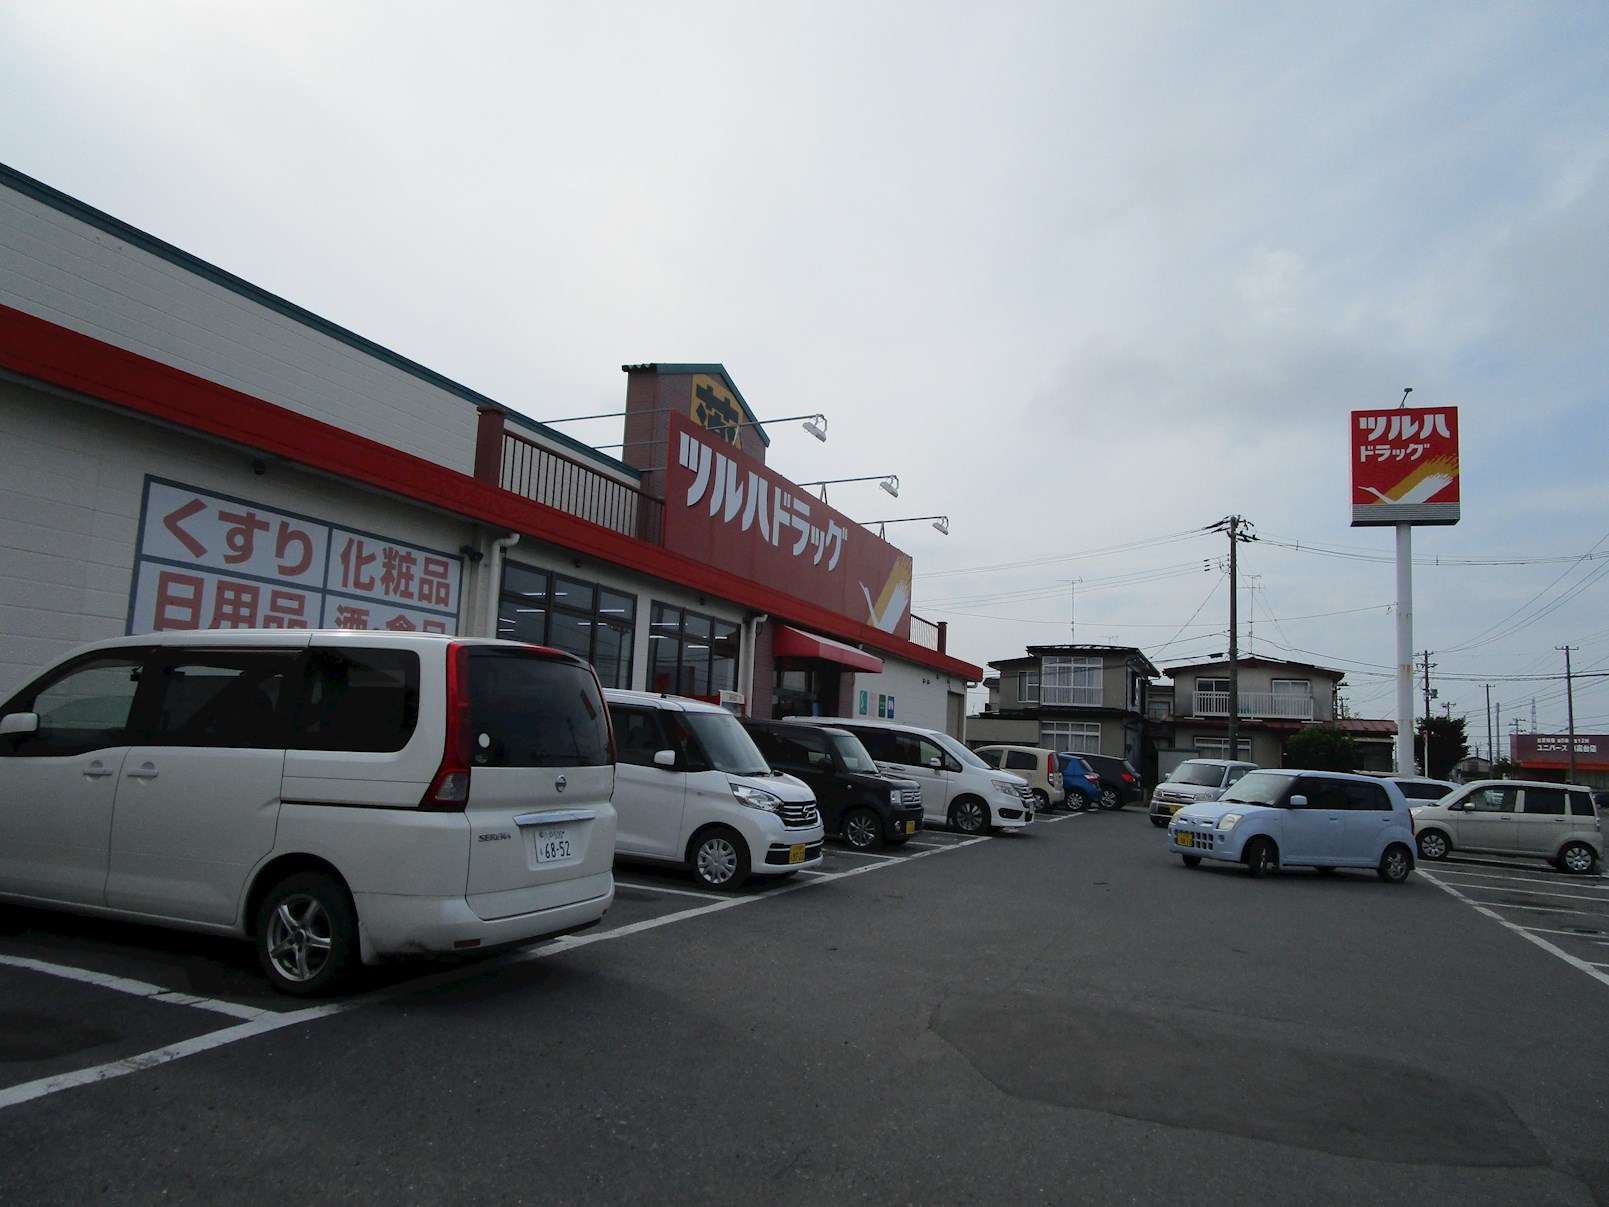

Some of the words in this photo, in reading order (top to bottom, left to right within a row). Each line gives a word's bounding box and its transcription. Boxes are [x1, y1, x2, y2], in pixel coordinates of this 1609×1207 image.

[1359, 414, 1450, 441] ツルハ
[1360, 443, 1430, 462] ドラッグ
[679, 431, 848, 572] ツルハドラッグ
[163, 498, 313, 577] くすり
[153, 571, 308, 632] 日用品
[340, 537, 450, 607] 化粧品
[478, 834, 512, 843] SERENA
